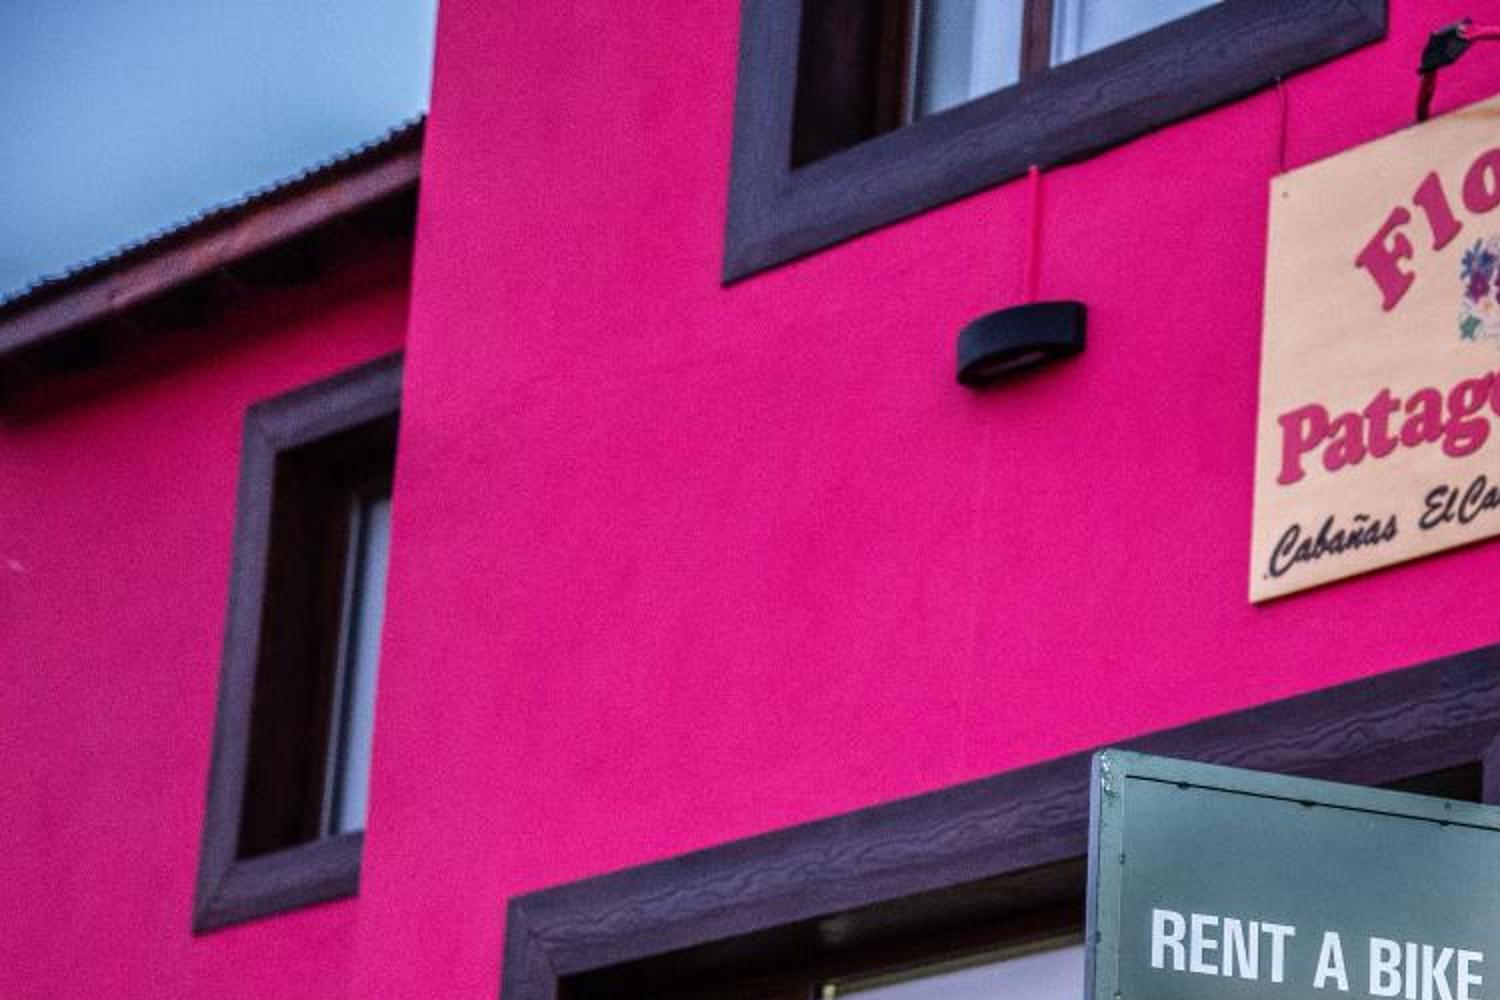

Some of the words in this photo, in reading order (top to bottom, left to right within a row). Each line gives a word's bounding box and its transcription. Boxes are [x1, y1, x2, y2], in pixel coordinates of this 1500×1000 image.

[1268, 513, 1398, 578] Cabañas
[1151, 908, 1296, 983] RENT
[1312, 931, 1350, 992] A
